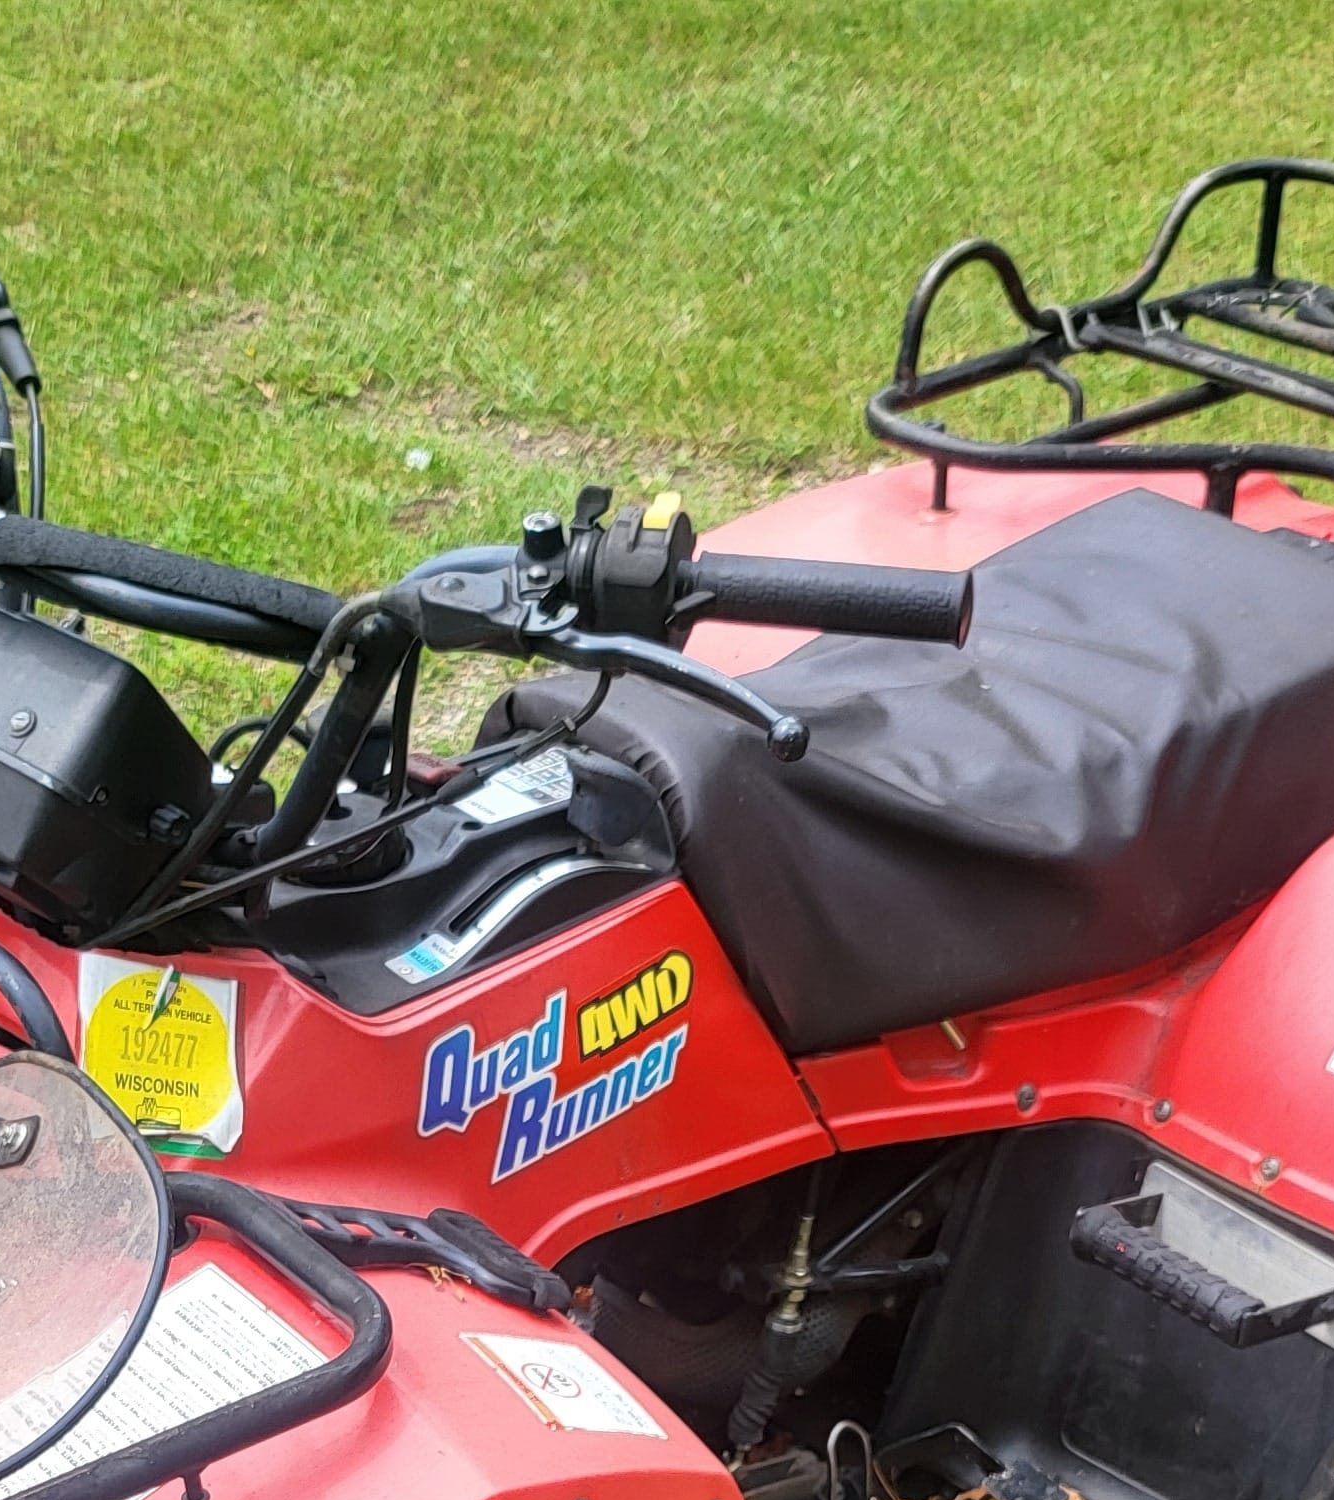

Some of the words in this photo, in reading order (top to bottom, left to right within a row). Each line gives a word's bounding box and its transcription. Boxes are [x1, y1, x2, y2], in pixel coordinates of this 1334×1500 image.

[114, 999, 131, 1011] ALL
[174, 1008, 212, 1024] VEHICLE
[578, 950, 693, 1061] 4WD
[115, 1072, 199, 1098] WISCONSIN
[121, 1025, 198, 1069] 192477
[419, 988, 567, 1136] Quad
[493, 1024, 688, 1184] Runner
